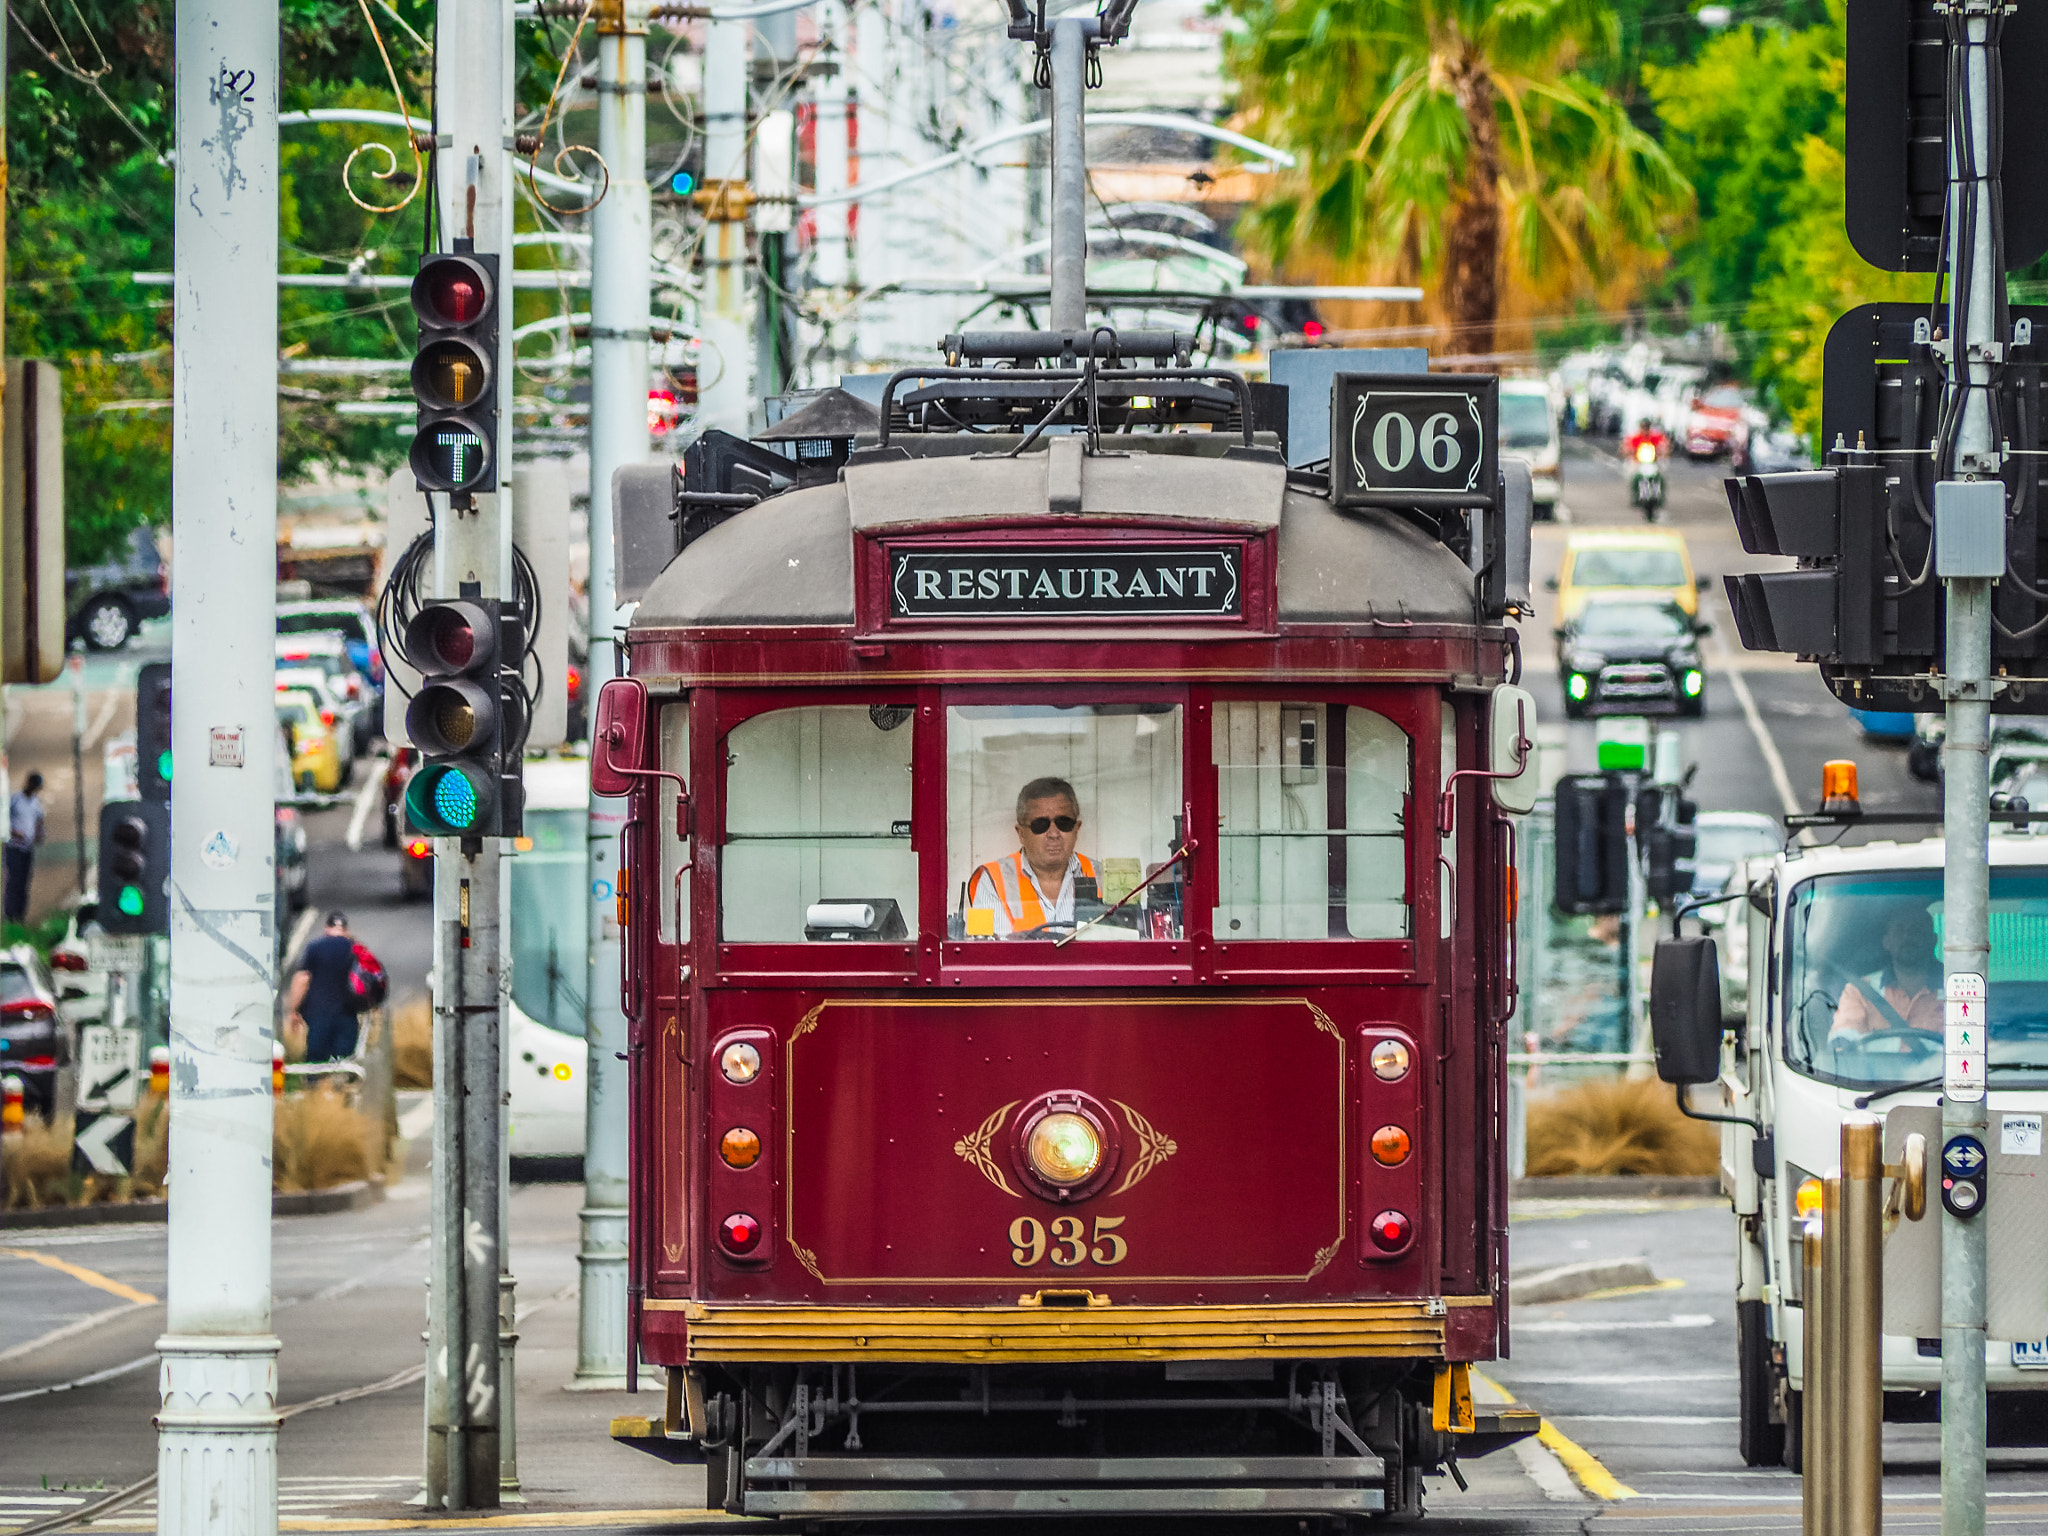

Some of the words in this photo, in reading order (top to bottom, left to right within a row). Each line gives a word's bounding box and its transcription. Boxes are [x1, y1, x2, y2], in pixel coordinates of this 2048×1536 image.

[1373, 411, 1462, 473] 06
[914, 566, 1216, 600] RESTAURANT
[1008, 1215, 1128, 1268] 935
